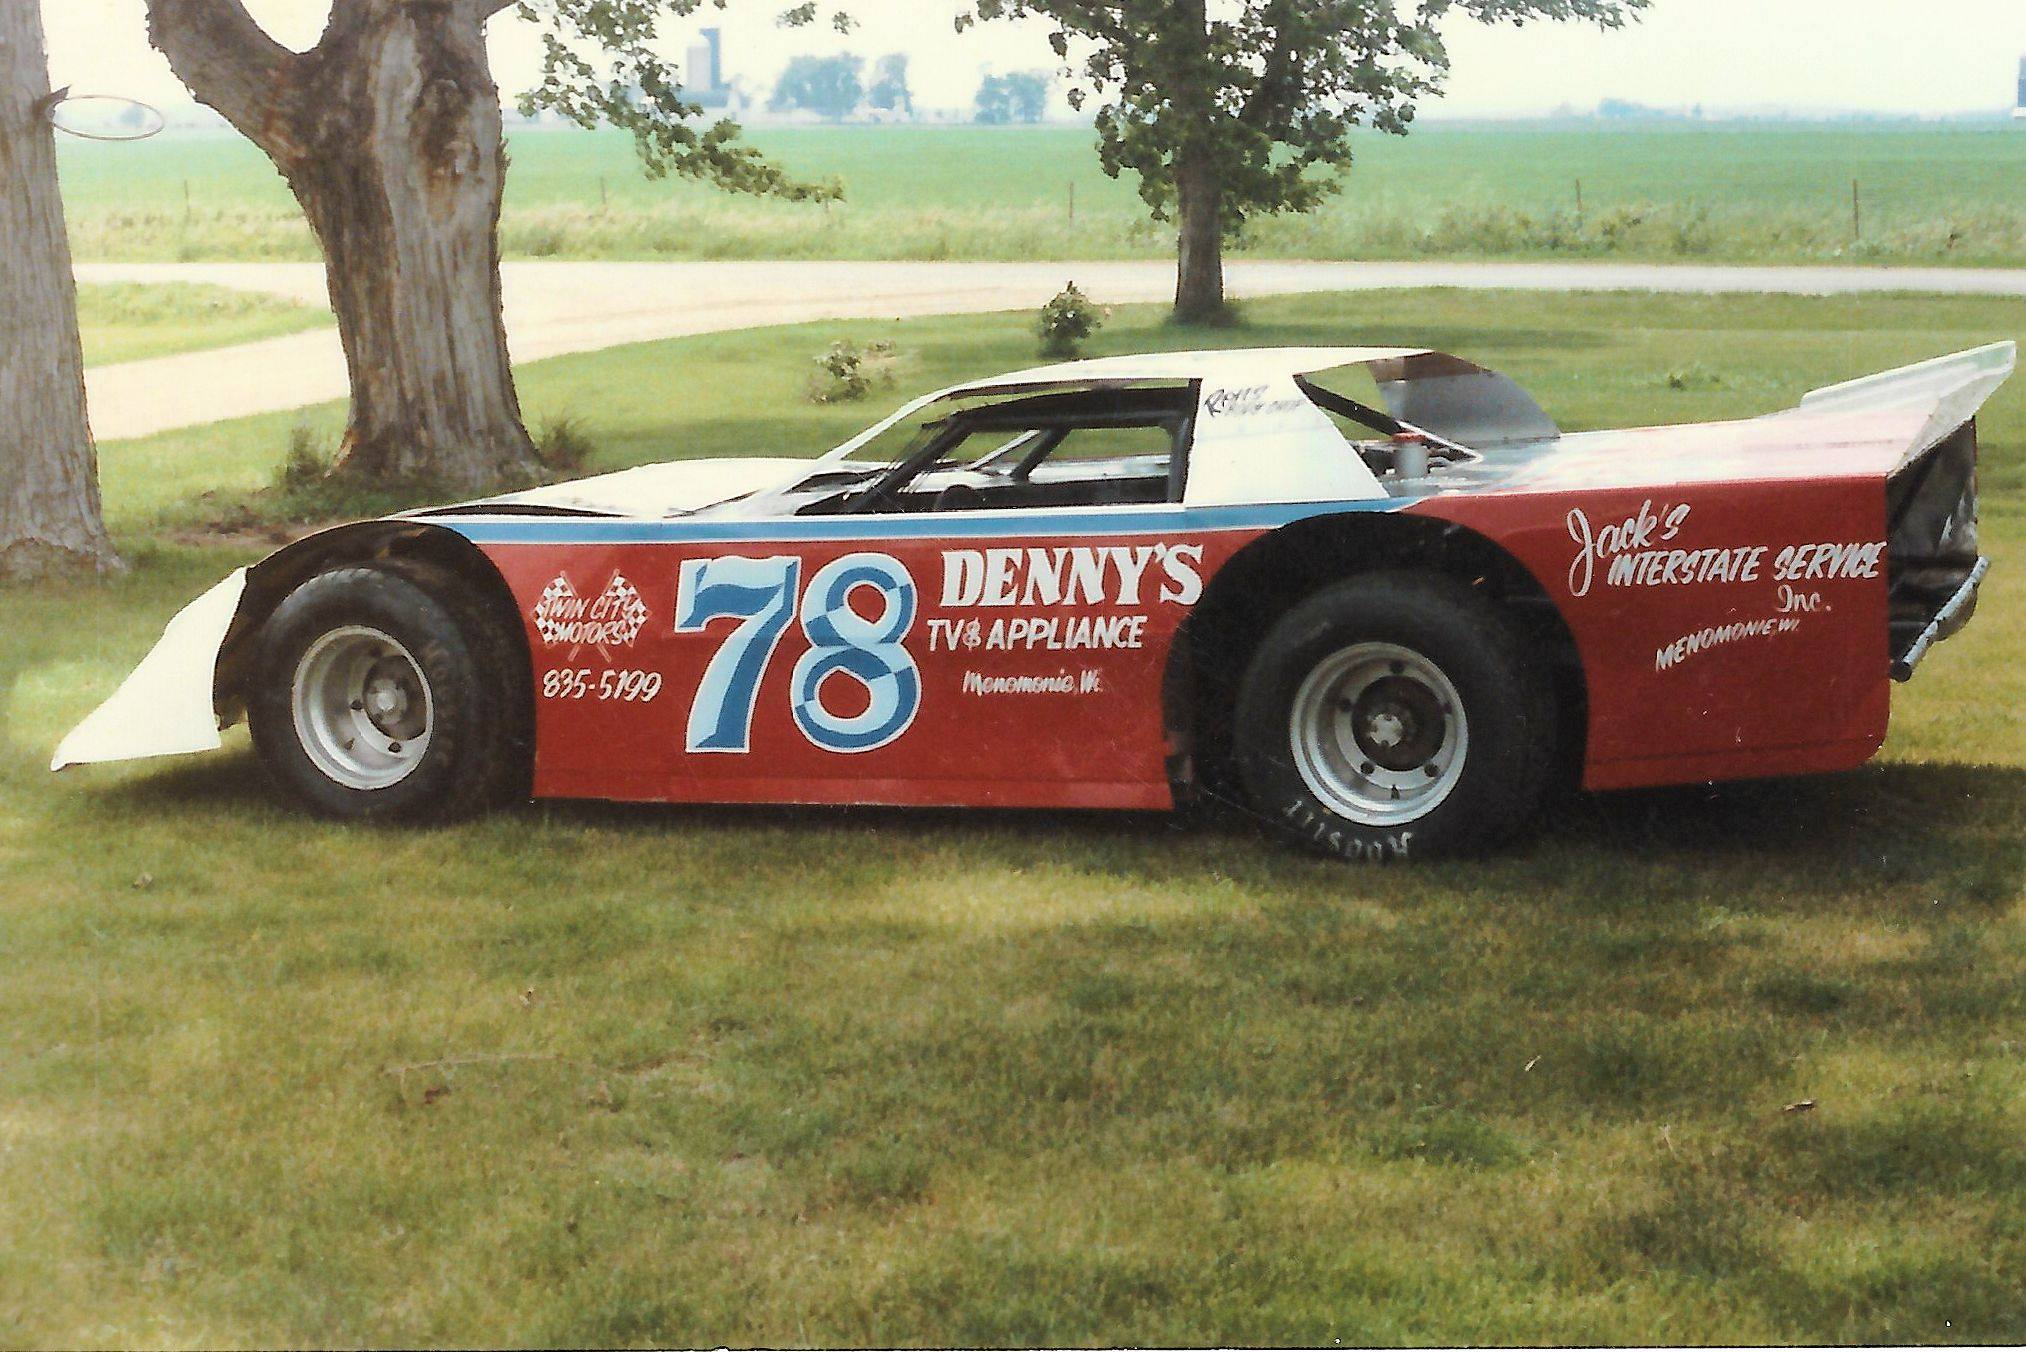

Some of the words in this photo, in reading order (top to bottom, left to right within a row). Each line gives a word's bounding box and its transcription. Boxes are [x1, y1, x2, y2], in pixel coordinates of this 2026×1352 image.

[1566, 498, 1692, 598] Jack's
[1606, 546, 1769, 588] INTERSTATE
[1772, 540, 1888, 582] SERVICE
[939, 541, 1205, 607] DENNY'S
[541, 597, 590, 620] TWIN
[590, 595, 642, 620] CITY
[1776, 584, 1832, 613] Inc.
[553, 620, 625, 645] MOTORS
[985, 615, 1148, 651] APPLIANCE
[674, 551, 922, 754] 78
[542, 668, 662, 702] 835-5199
